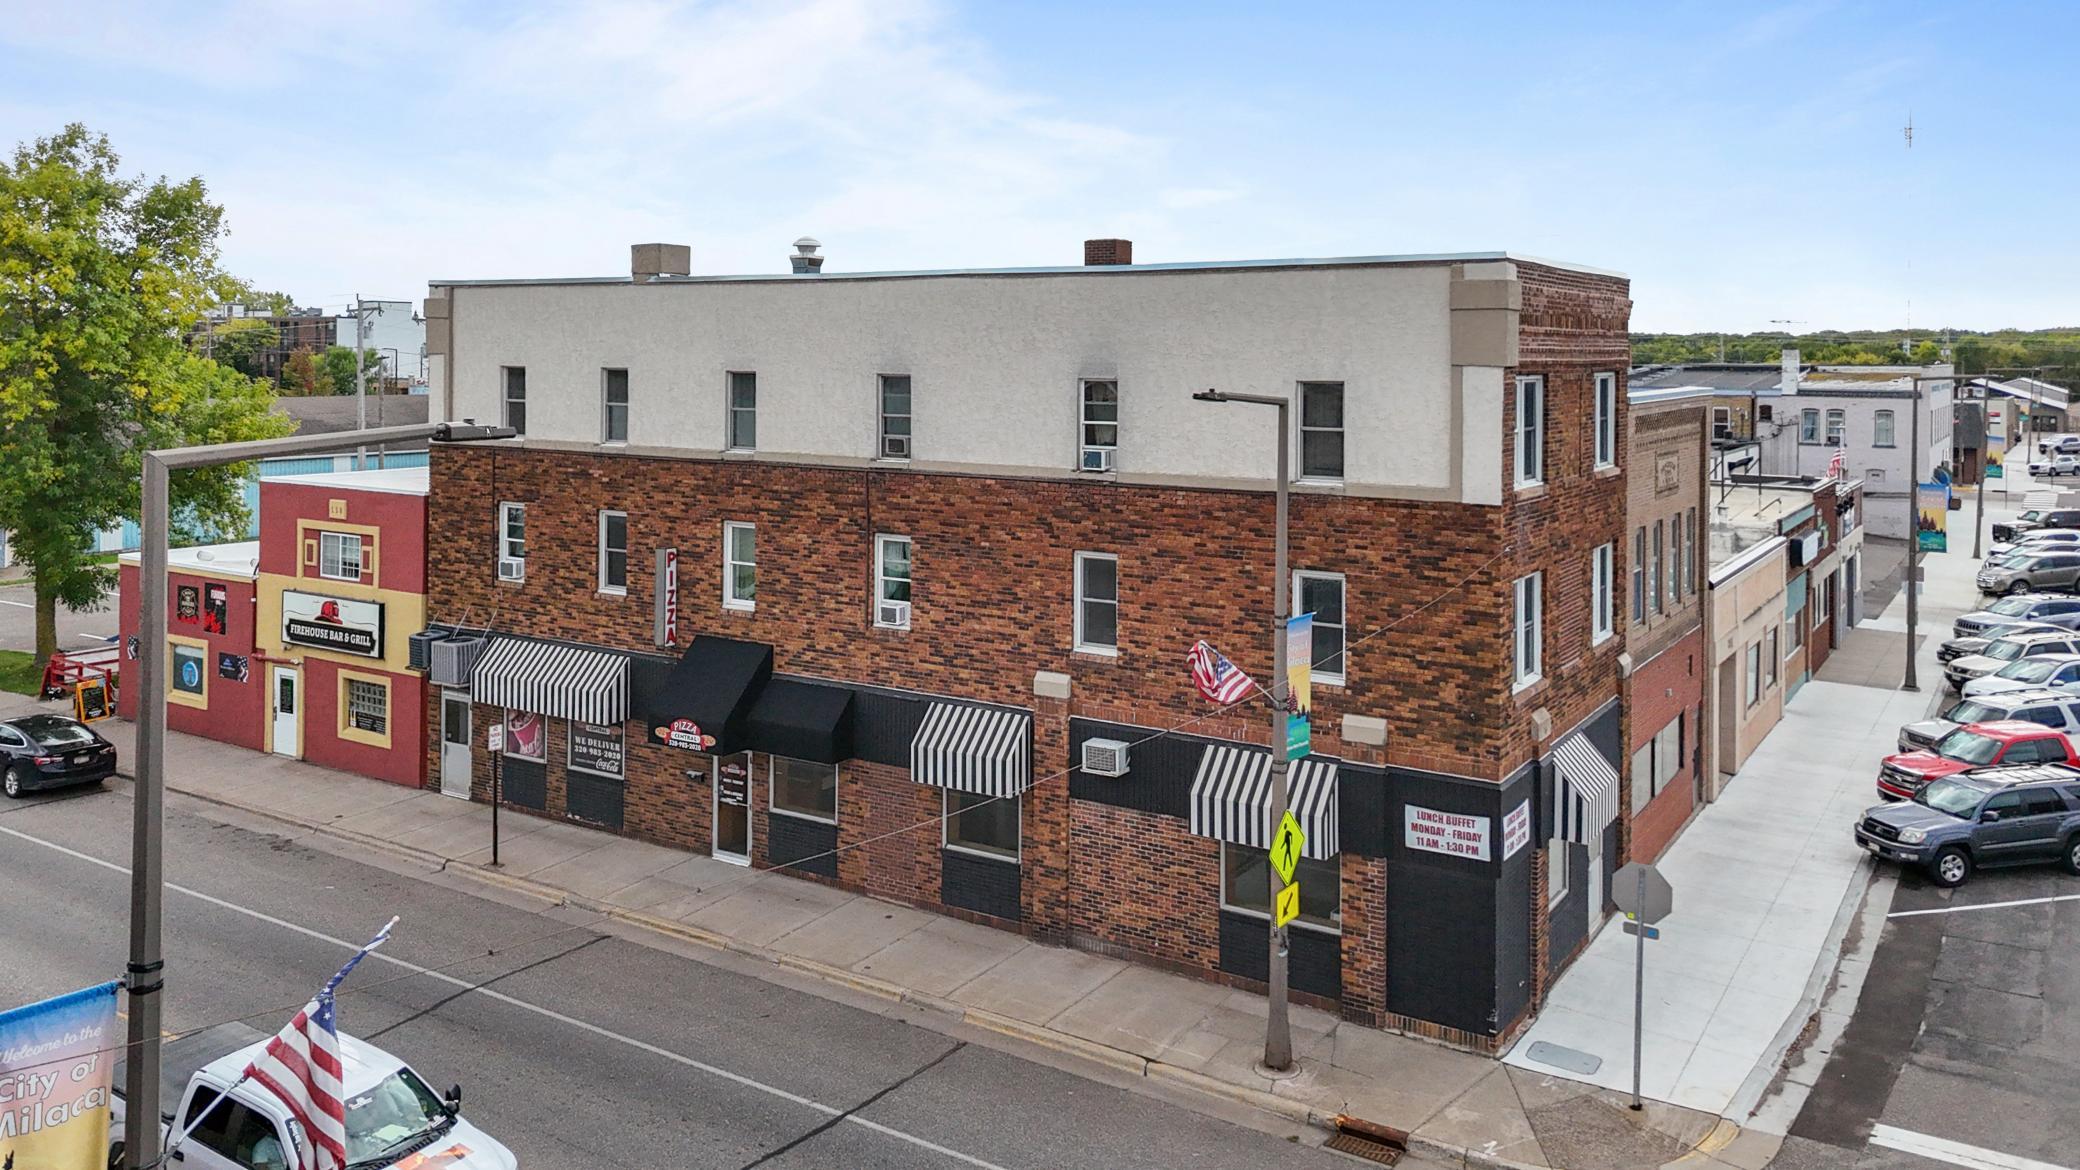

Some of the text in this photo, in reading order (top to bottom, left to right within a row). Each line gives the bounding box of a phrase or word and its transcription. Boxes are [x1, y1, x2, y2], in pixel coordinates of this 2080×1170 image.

[666, 551, 677, 645] PIZZA
[290, 623, 371, 646] FIREHOUSE BAR & GRILL
[674, 720, 697, 735] PIZZA
[674, 732, 698, 742] CENTRAL
[575, 735, 620, 751] WE DELIVER
[1417, 810, 1476, 829] LUNCH BUFFET
[1410, 822, 1446, 837] MONDAY
[1452, 829, 1482, 843] FRIDAY
[1416, 836, 1424, 847] 11
[1425, 837, 1439, 849] AM
[1446, 841, 1463, 853] 1:30
[1466, 844, 1479, 856] PM
[0, 1025, 102, 1064] Welcome to the
[0, 1070, 59, 1104] City
